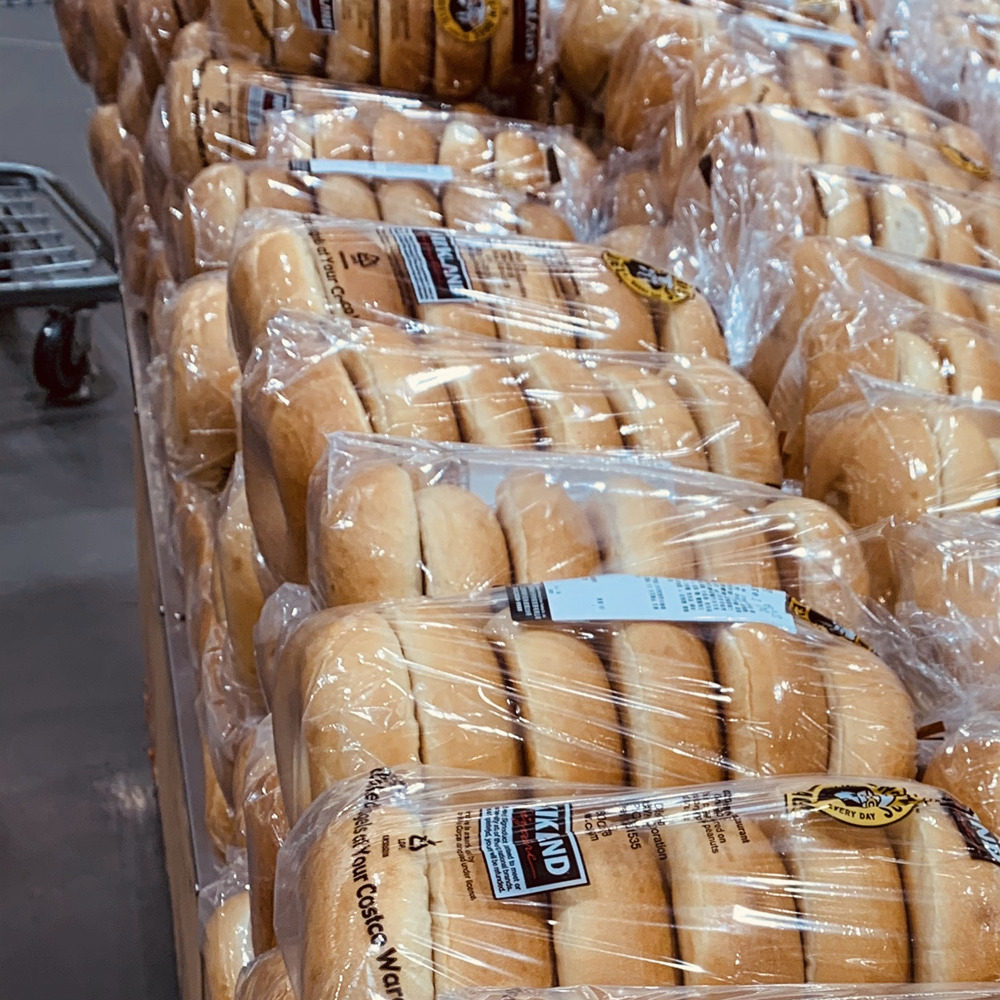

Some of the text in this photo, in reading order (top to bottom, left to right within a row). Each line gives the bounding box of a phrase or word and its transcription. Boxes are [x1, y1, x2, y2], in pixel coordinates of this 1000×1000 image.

[859, 811, 877, 822] DAY
[703, 823, 720, 855] peanuts
[351, 845, 371, 885] Your
[355, 882, 389, 948] Costco
